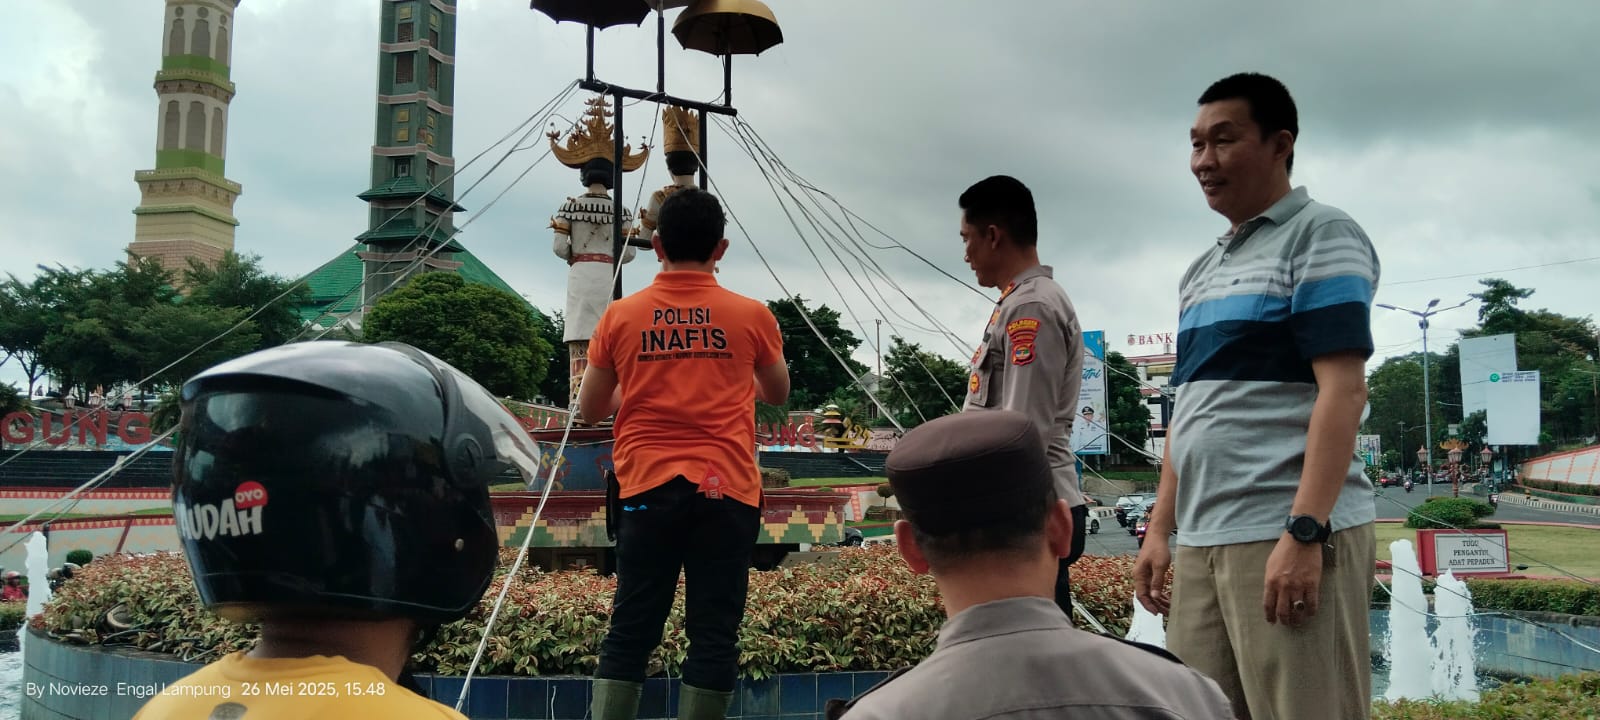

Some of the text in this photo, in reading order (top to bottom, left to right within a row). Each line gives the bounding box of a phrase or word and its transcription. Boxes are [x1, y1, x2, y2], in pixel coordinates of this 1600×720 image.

[653, 308, 711, 325] POLISI
[641, 328, 727, 352] INAFIS
[1138, 332, 1173, 345] BANK
[235, 489, 264, 503] OYO
